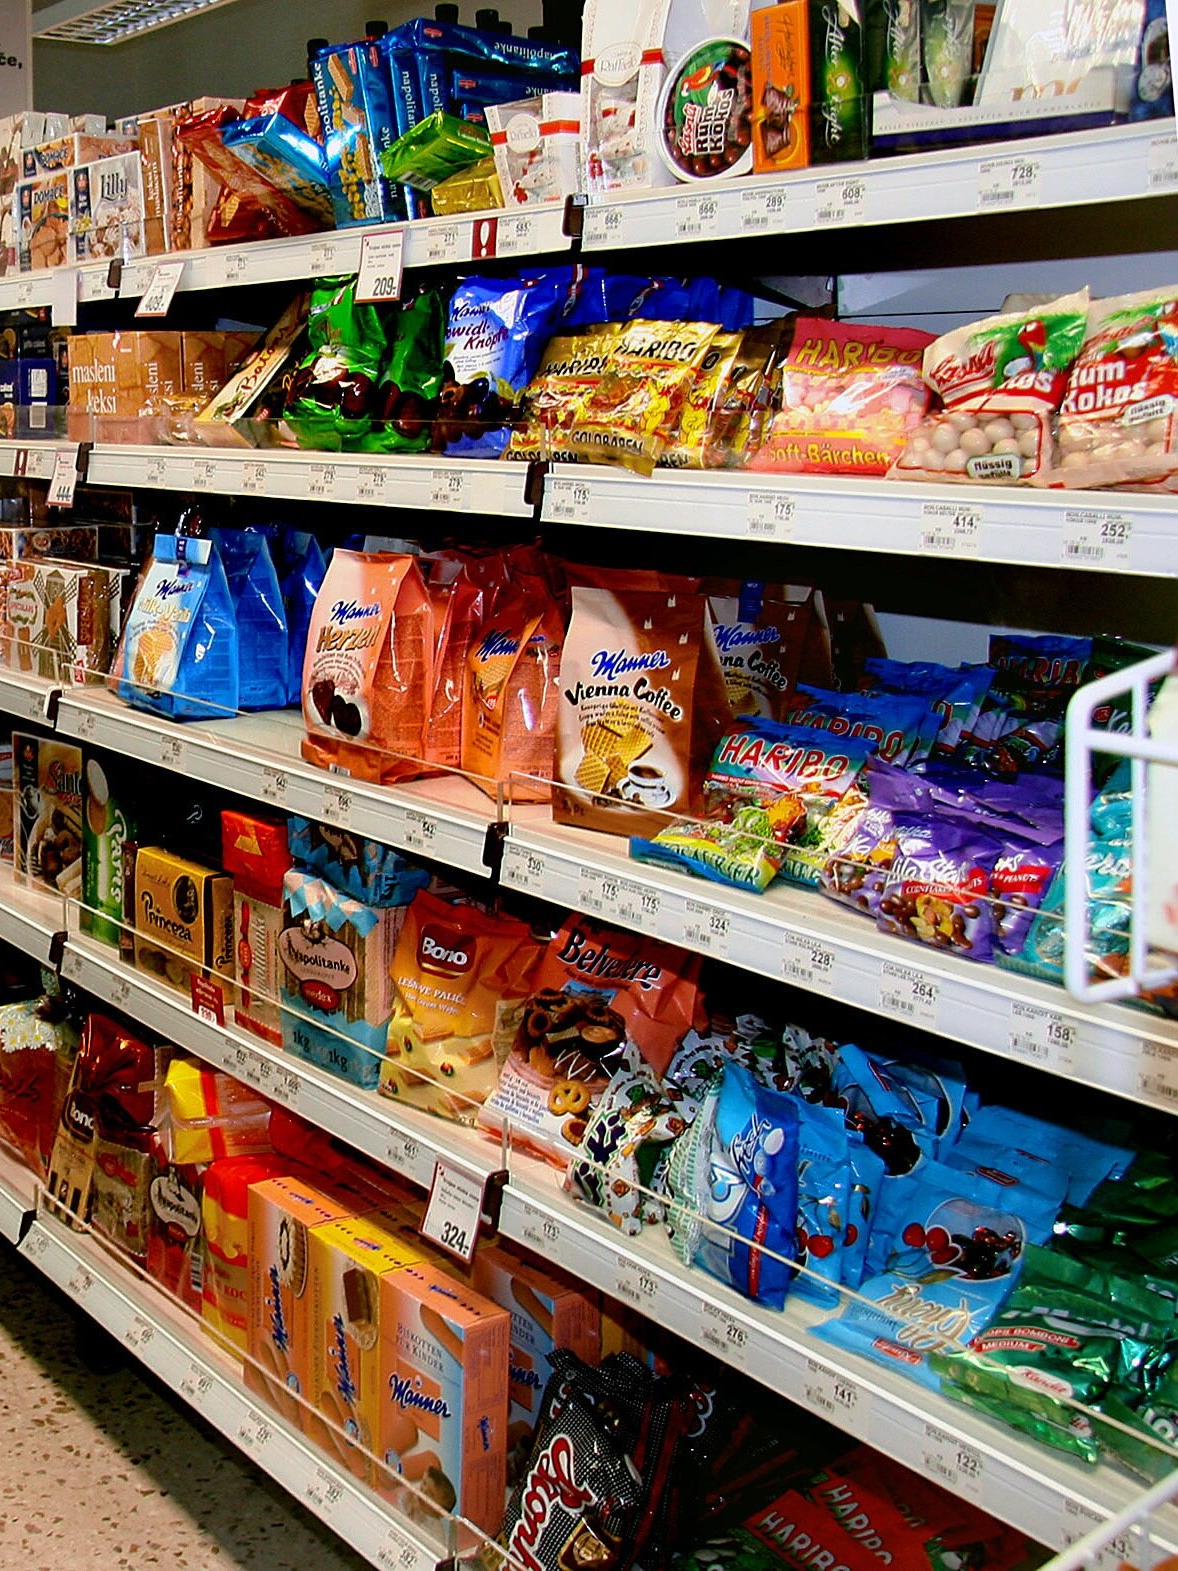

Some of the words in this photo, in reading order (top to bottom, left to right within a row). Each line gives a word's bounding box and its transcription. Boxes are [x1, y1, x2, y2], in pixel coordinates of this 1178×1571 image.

[100, 173, 127, 201] Lilly
[616, 340, 697, 361] HARIBO
[72, 357, 115, 383] masleni
[87, 389, 116, 413] keksi
[332, 600, 382, 625] Manner
[317, 625, 379, 654] Herzen
[475, 628, 521, 663] Mann
[591, 649, 671, 682] Manner
[747, 651, 788, 692] Coffee
[565, 682, 630, 706] Vienna
[634, 678, 683, 721] Coffee
[719, 734, 849, 782] HARIBO
[141, 890, 193, 943] Princeza
[422, 937, 468, 966] Bono
[557, 928, 662, 990] Belvedere
[293, 1031, 310, 1052] 1kg
[329, 1051, 347, 1072] 1kg
[389, 1371, 452, 1419] Manner
